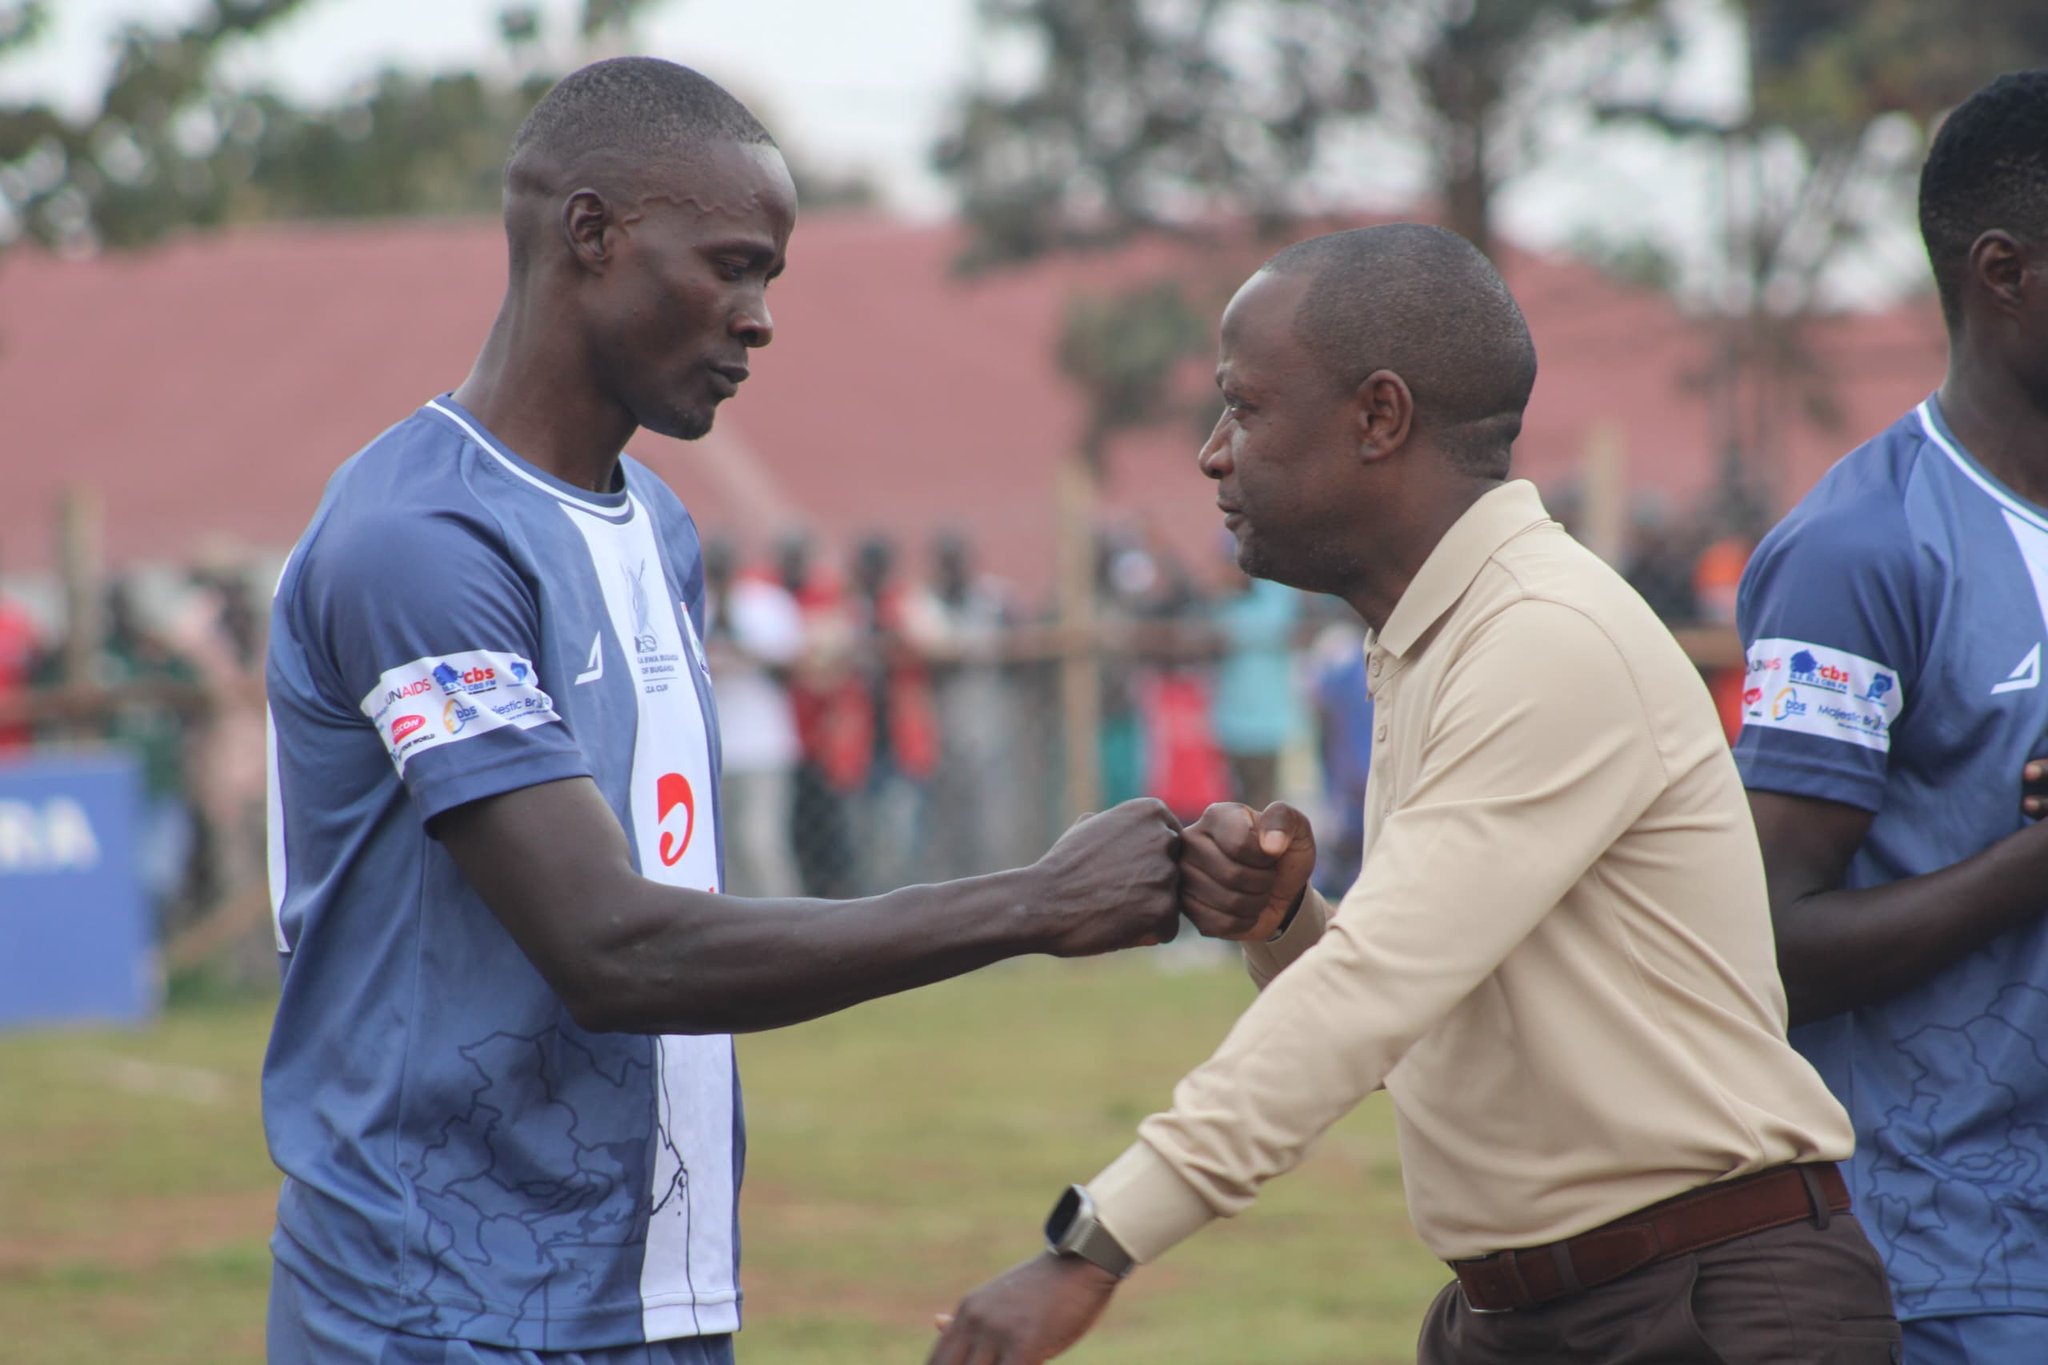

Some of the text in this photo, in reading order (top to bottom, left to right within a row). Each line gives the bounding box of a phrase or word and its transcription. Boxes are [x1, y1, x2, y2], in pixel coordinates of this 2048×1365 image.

[464, 667, 496, 684] cbs
[1821, 665, 1849, 683] cbs
[455, 705, 478, 719] bbs
